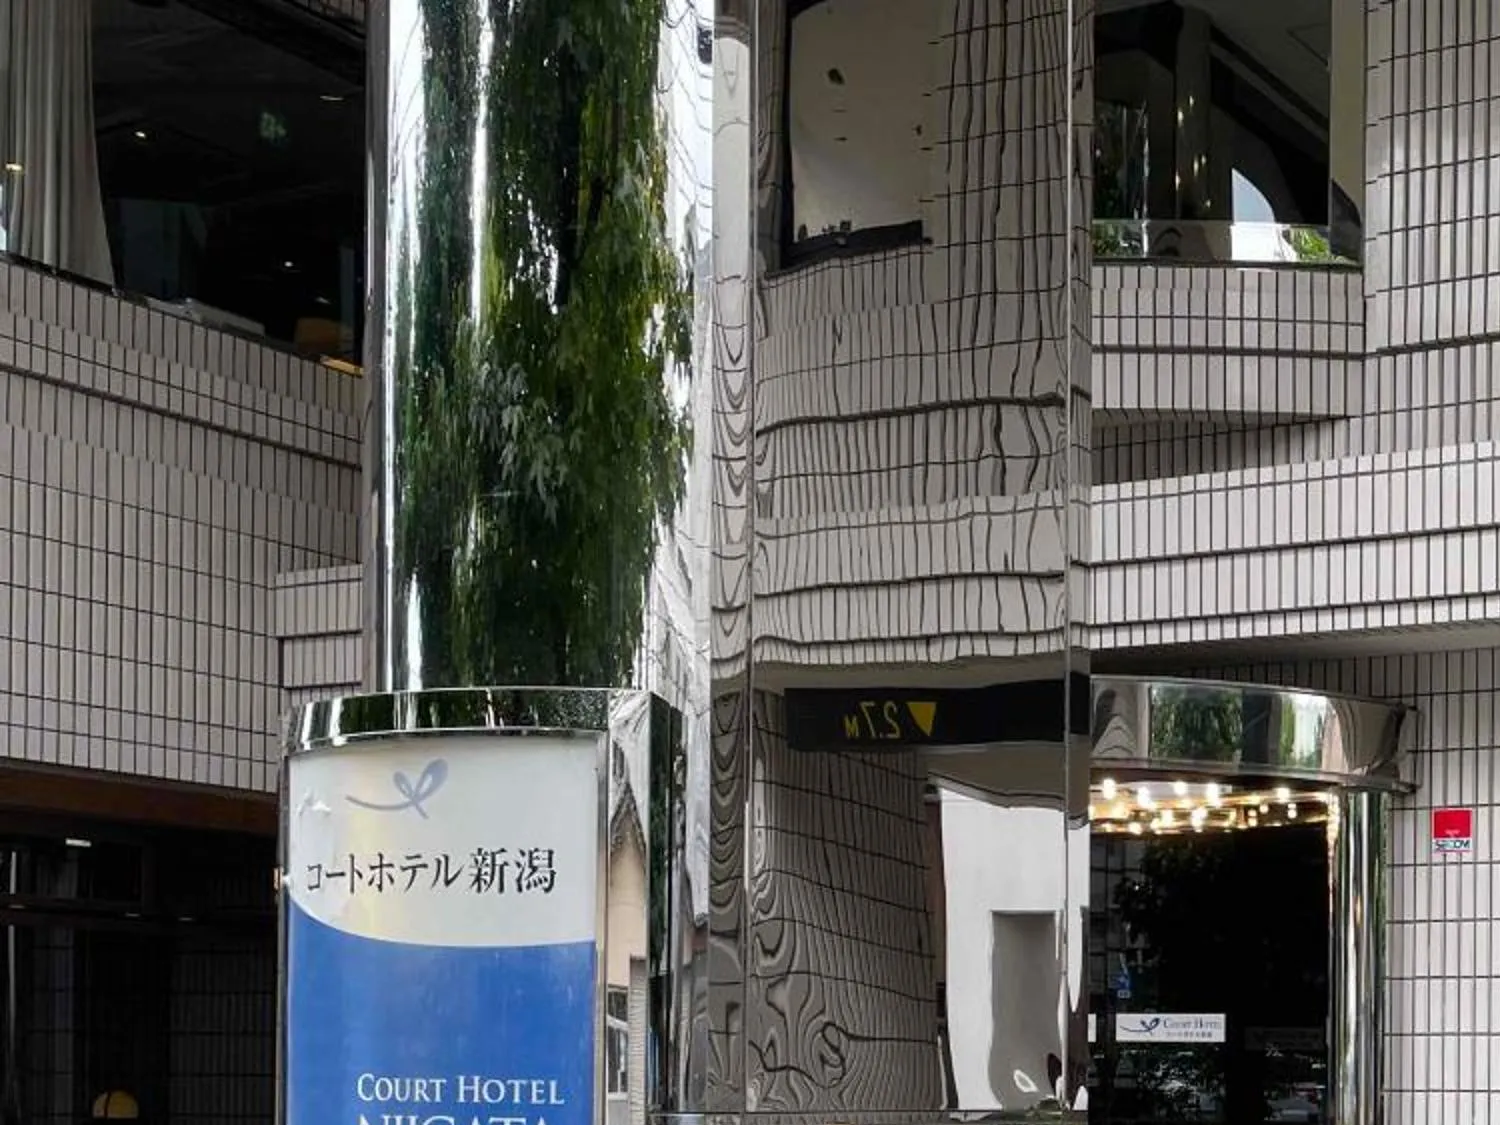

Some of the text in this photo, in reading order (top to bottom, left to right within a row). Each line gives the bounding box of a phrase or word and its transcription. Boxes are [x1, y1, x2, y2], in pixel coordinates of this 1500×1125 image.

[306, 847, 557, 895] コートホテル新潟
[355, 1073, 565, 1105] COURT HOTEL
